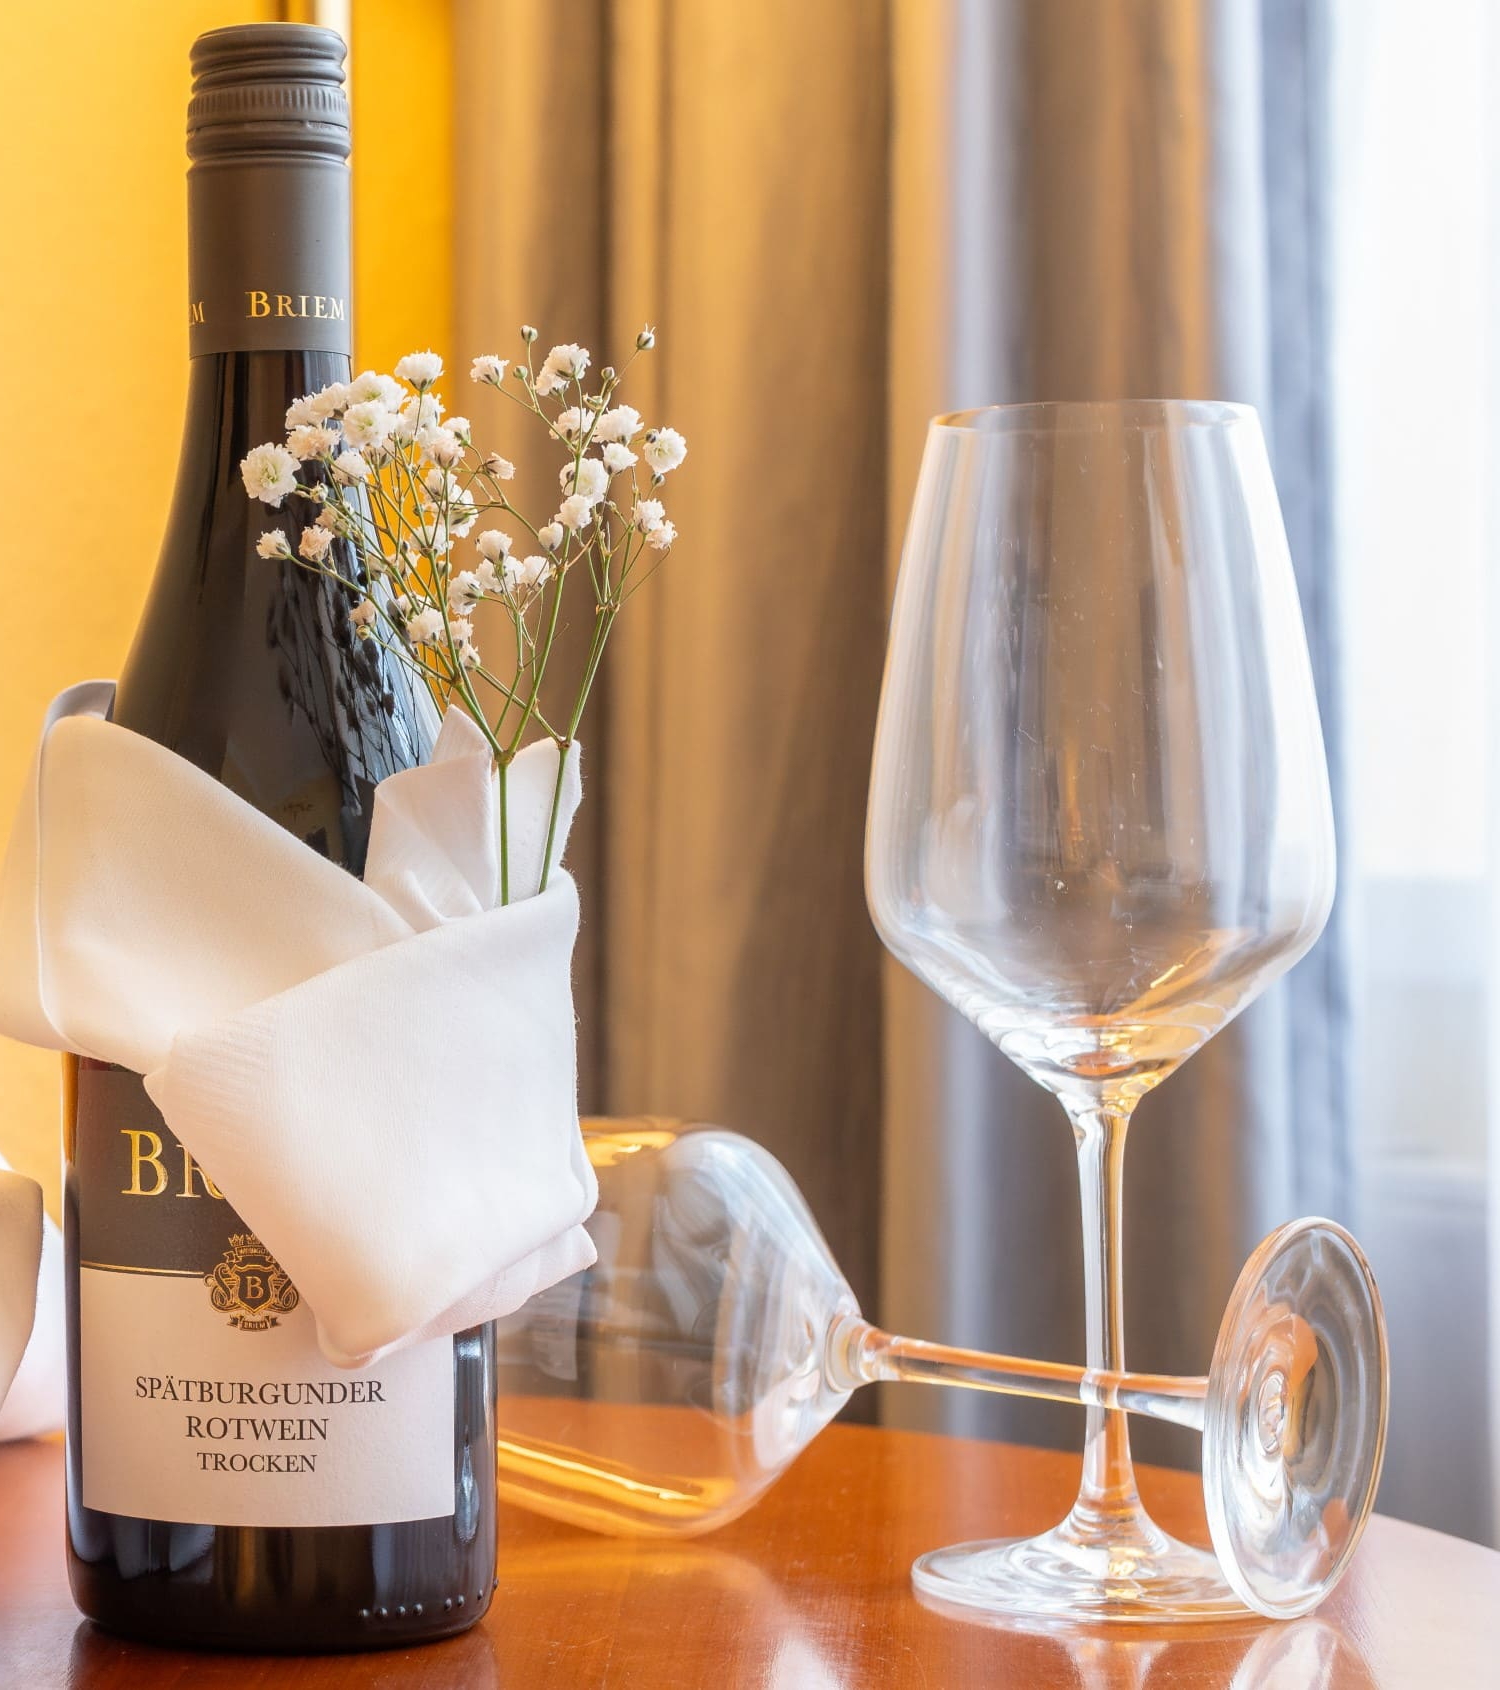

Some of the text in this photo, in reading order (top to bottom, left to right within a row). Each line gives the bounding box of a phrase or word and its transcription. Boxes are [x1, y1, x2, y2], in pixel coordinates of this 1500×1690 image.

[245, 291, 346, 321] BRIEM
[245, 1276, 264, 1300] B
[135, 1375, 386, 1404] SPÄTBURGUNDER
[185, 1415, 329, 1441] ROTWEIN
[197, 1452, 317, 1473] TROCKEN
